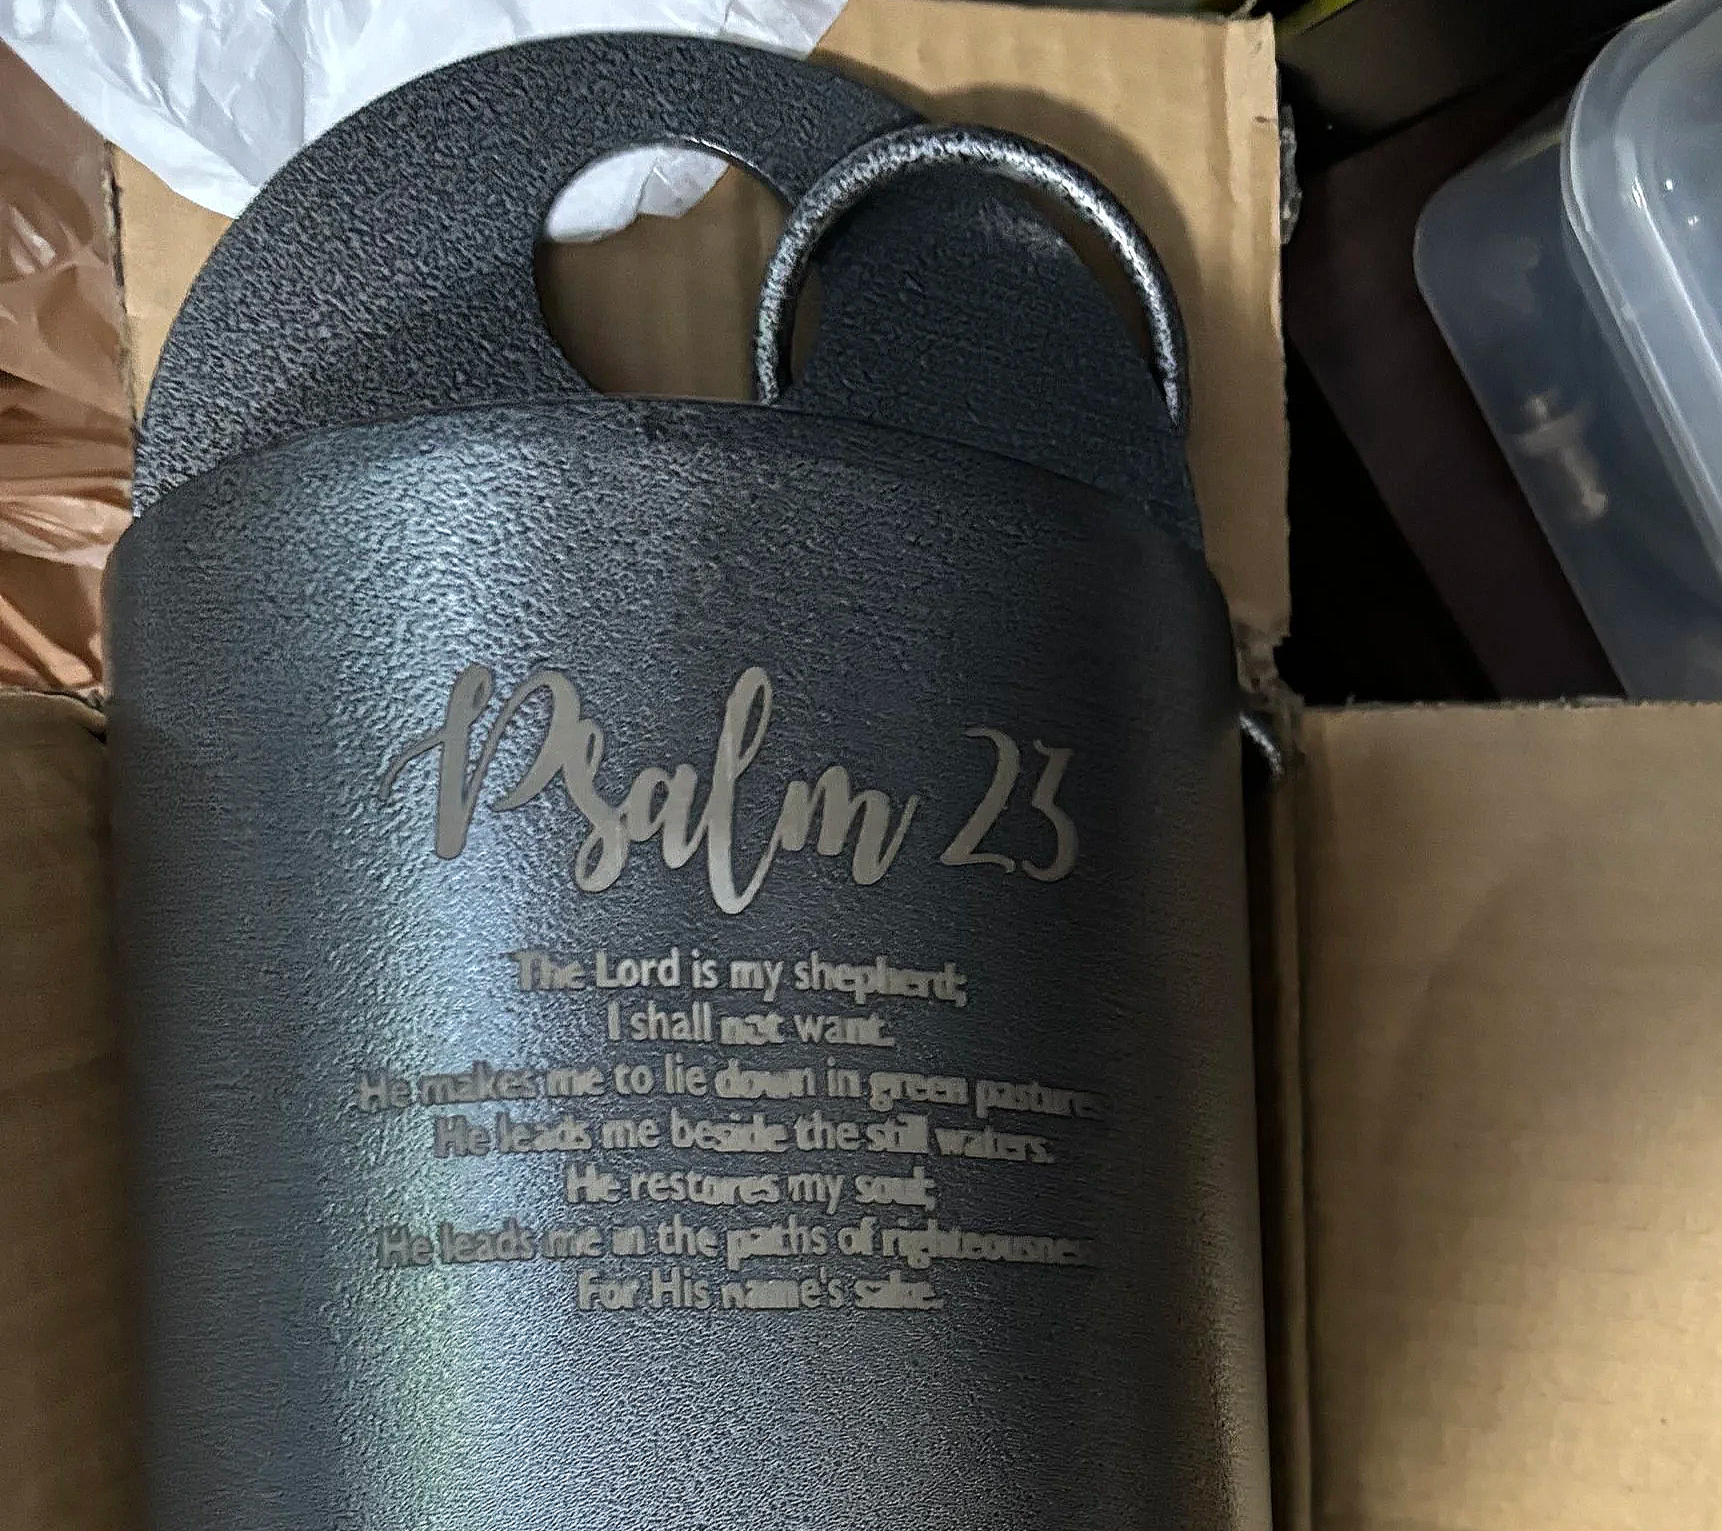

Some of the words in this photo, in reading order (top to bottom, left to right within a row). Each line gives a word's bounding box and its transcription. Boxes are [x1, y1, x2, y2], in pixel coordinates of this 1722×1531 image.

[380, 663, 918, 915] Psalm
[939, 725, 1080, 882] 23
[512, 950, 586, 989] The
[595, 946, 681, 988] Lord
[691, 948, 719, 989] is
[728, 959, 784, 1002] my
[607, 1001, 621, 1040] I
[630, 1000, 712, 1042] shall
[719, 1010, 785, 1045] not
[360, 1073, 411, 1110] He
[418, 1060, 538, 1105] makes
[547, 1066, 605, 1097] me
[613, 1061, 653, 1095] to
[664, 1053, 708, 1097] lie
[714, 1058, 817, 1098] down
[827, 1055, 862, 1097] in
[869, 1070, 969, 1112] green
[434, 1115, 489, 1159] He
[496, 1110, 592, 1152] leads
[601, 1118, 660, 1149] me
[670, 1107, 789, 1151] beside
[795, 1110, 861, 1151] the
[864, 1114, 930, 1154] still
[566, 1162, 620, 1203] He
[629, 1170, 781, 1205] restores
[788, 1173, 845, 1216] my
[377, 1222, 434, 1268] He
[440, 1217, 536, 1264] leads
[540, 1226, 603, 1257] me
[656, 1213, 718, 1257] the
[726, 1214, 829, 1271] paths
[837, 1216, 876, 1256] of
[575, 1268, 642, 1311] For
[651, 1266, 712, 1310] His
[720, 1266, 848, 1309] name's
